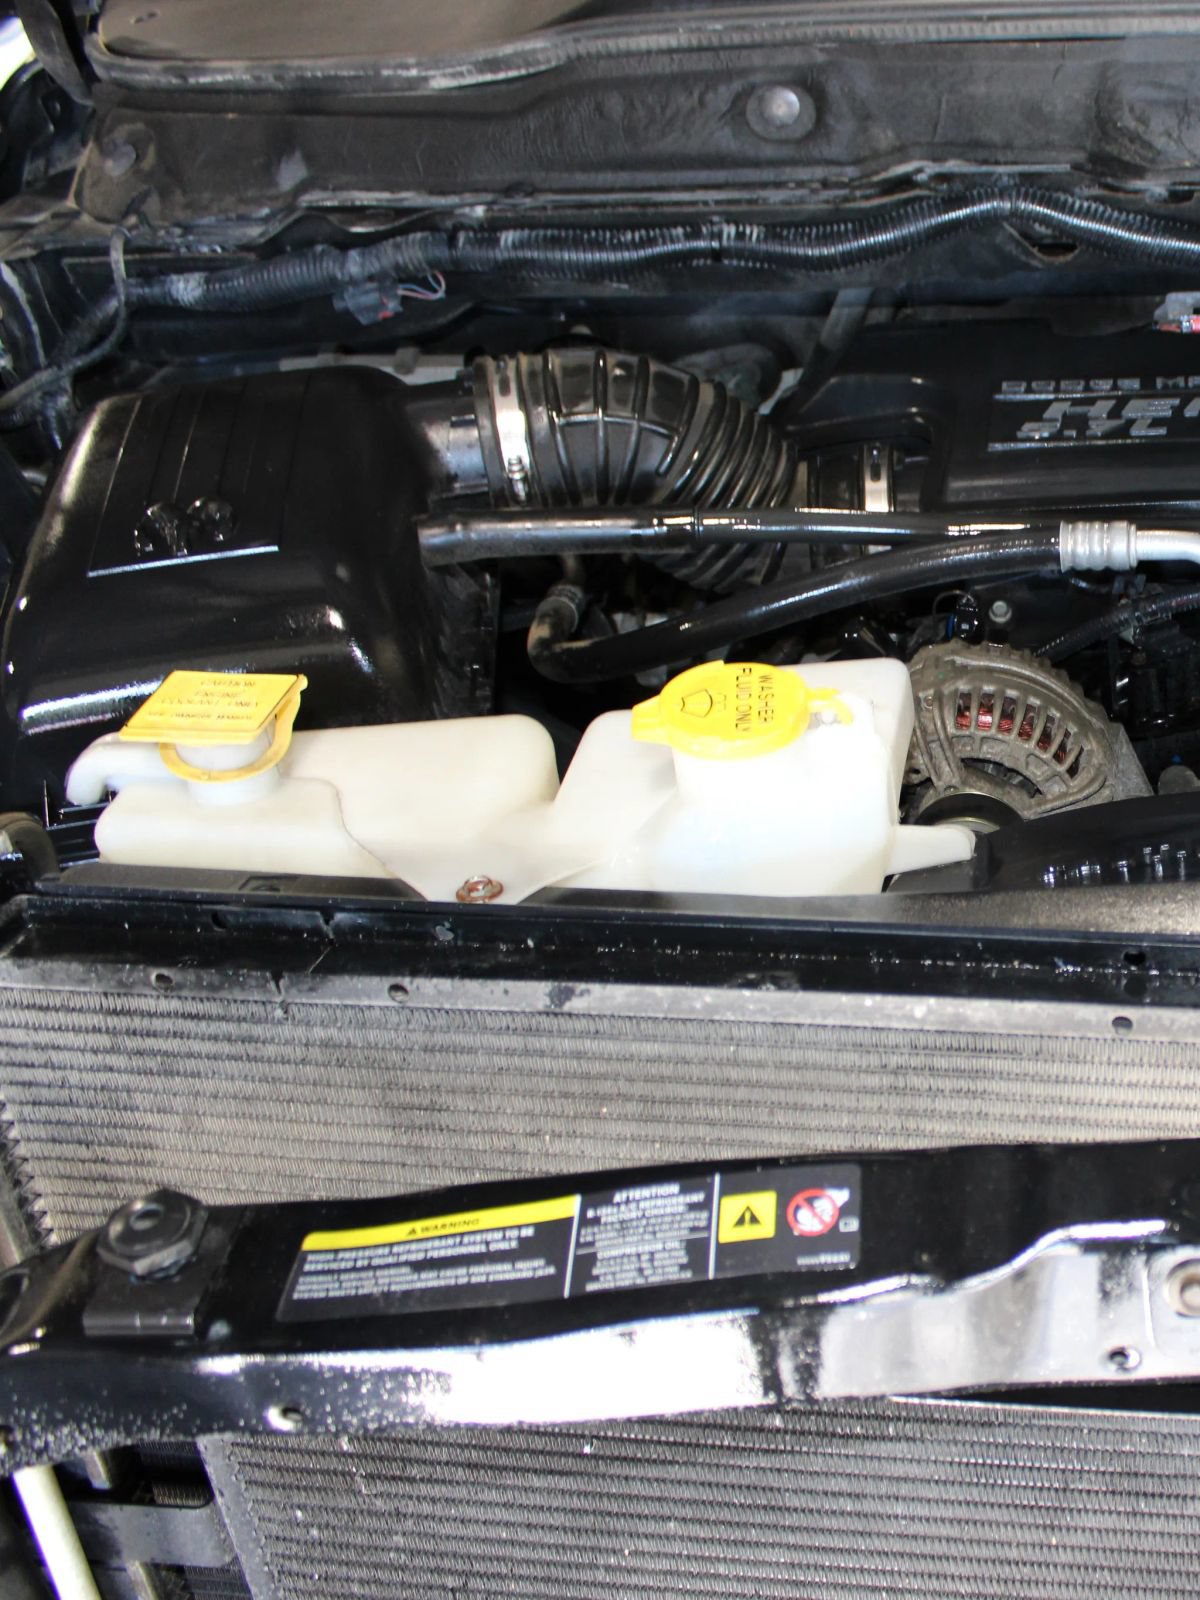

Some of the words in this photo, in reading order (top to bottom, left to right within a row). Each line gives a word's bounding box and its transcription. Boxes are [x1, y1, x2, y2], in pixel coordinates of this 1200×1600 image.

[735, 667, 752, 700] FLUID
[758, 673, 774, 724] WASHER
[735, 703, 752, 732] ONLY
[612, 1182, 680, 1204] ATTENTION
[420, 1218, 480, 1233] WARNING
